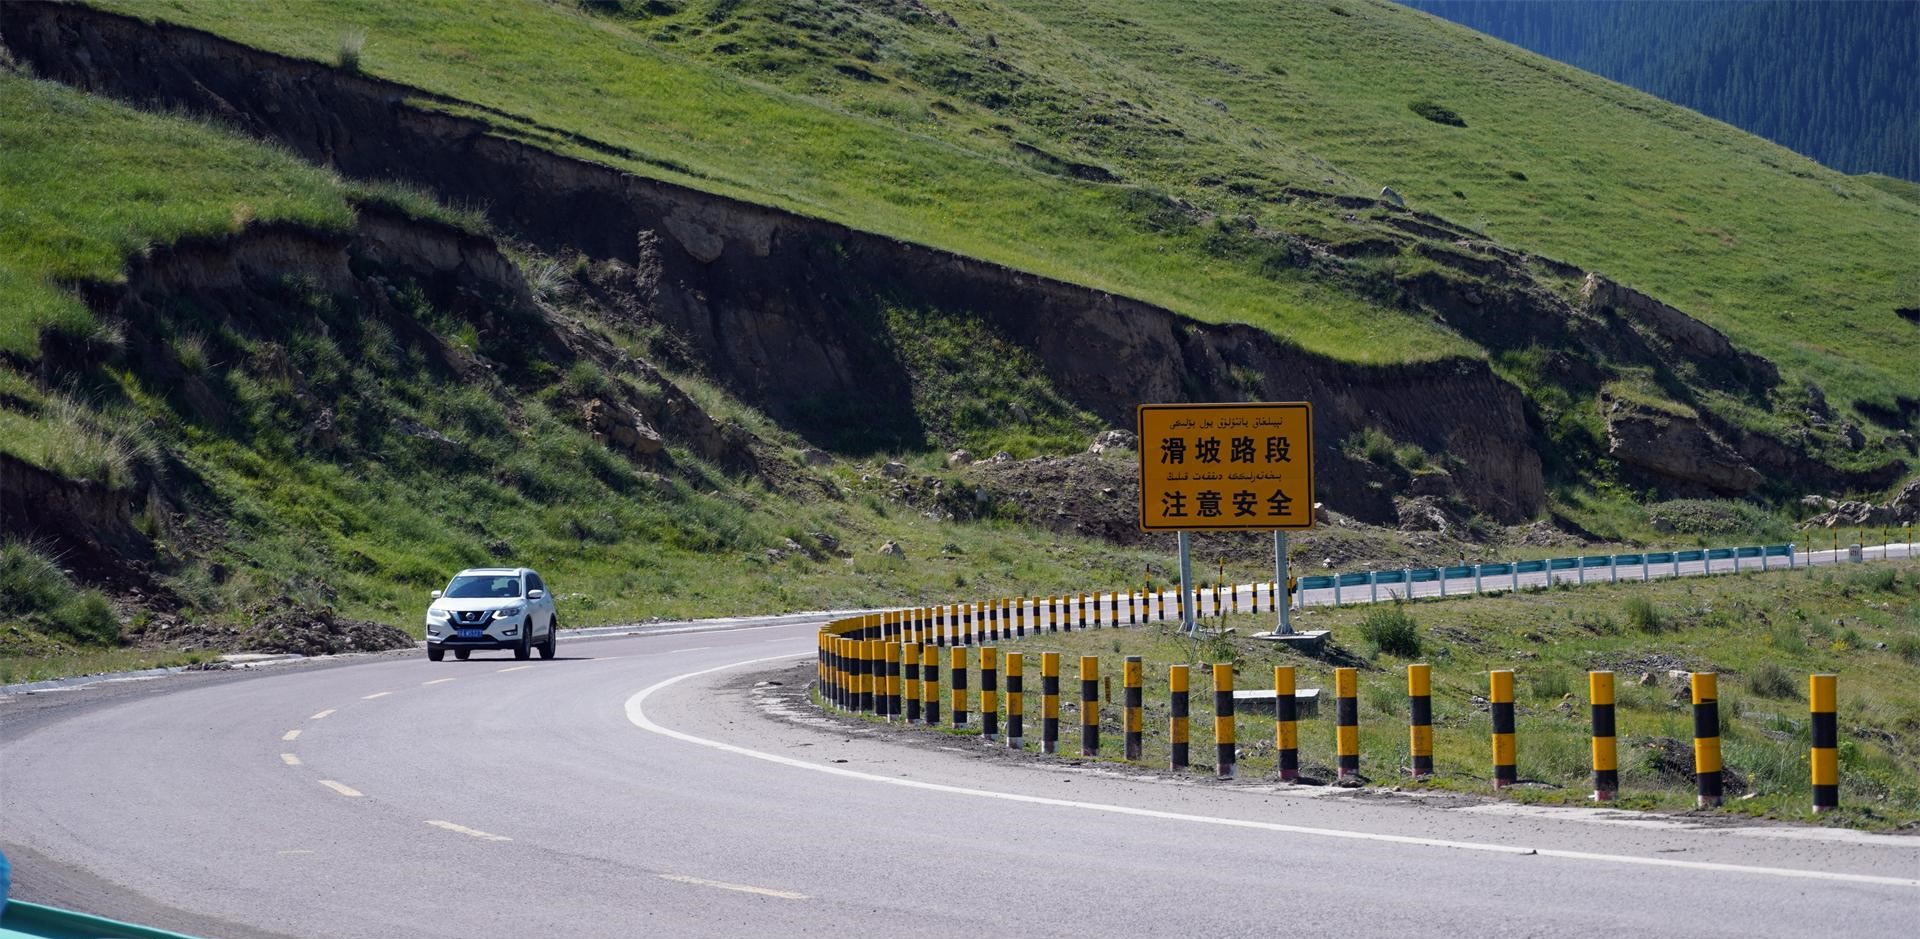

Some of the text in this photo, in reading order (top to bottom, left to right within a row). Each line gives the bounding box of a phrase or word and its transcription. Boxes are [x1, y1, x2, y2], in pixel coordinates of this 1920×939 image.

[1160, 436, 1292, 464] 滑坡路段
[1161, 489, 1293, 518] 注意安全
